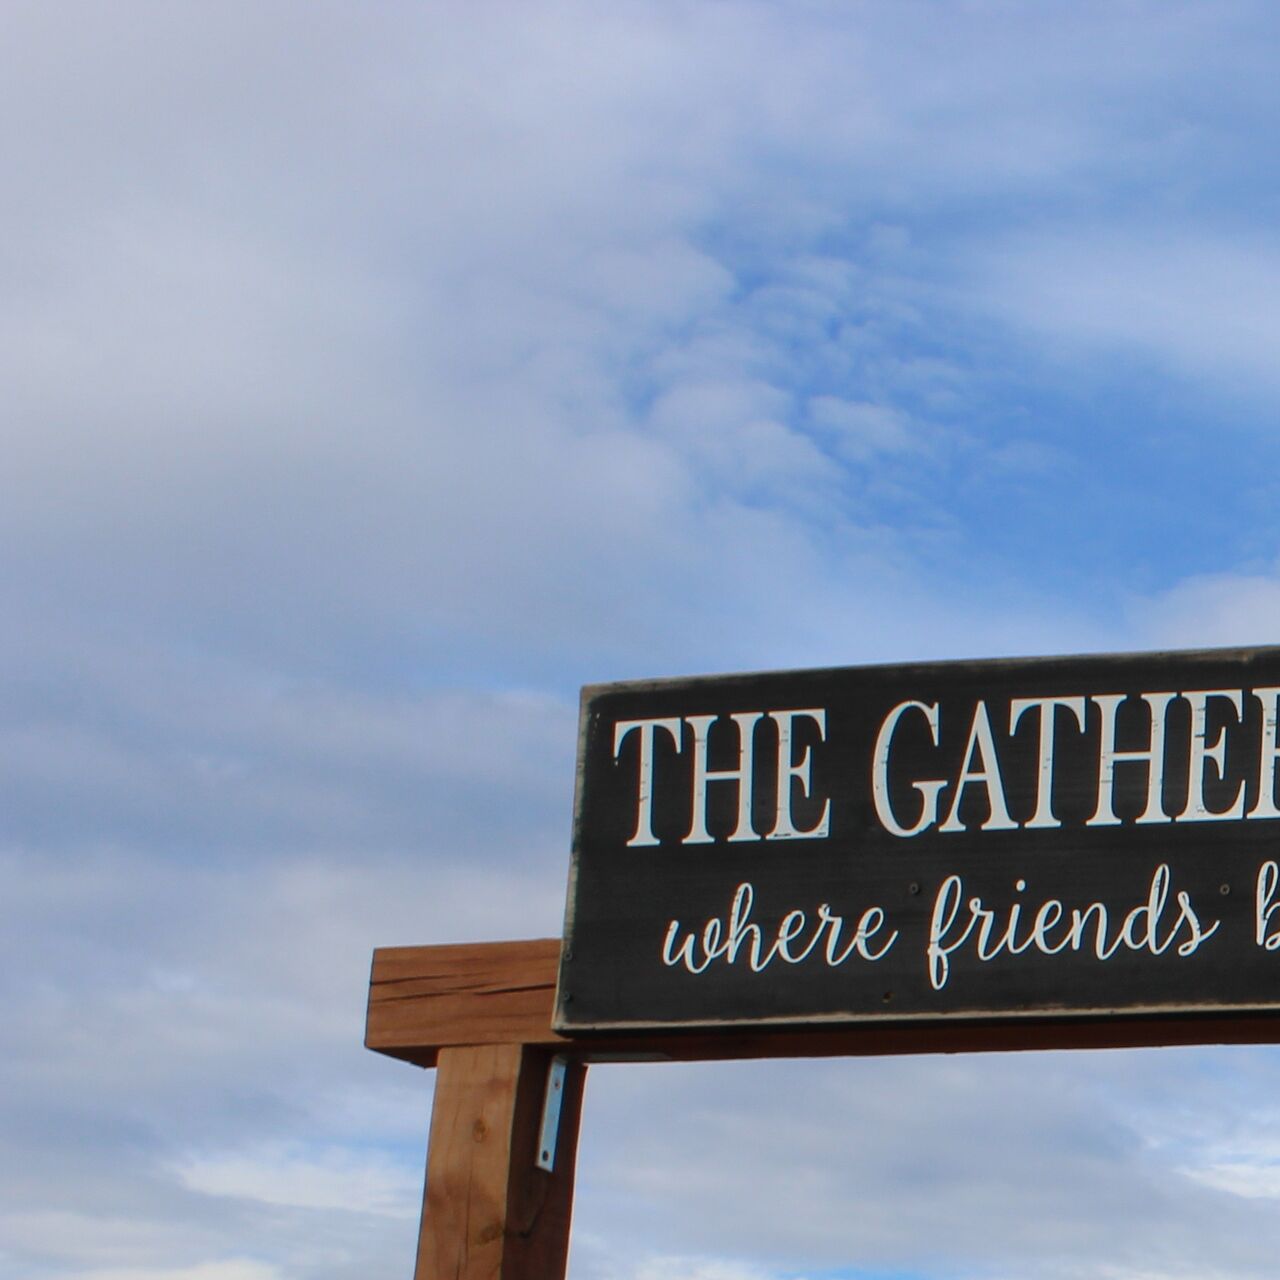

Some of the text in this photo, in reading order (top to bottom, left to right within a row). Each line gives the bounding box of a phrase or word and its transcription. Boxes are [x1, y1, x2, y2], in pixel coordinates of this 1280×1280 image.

[614, 709, 830, 846] THE
[663, 883, 898, 973] where
[928, 865, 1219, 989] friends
